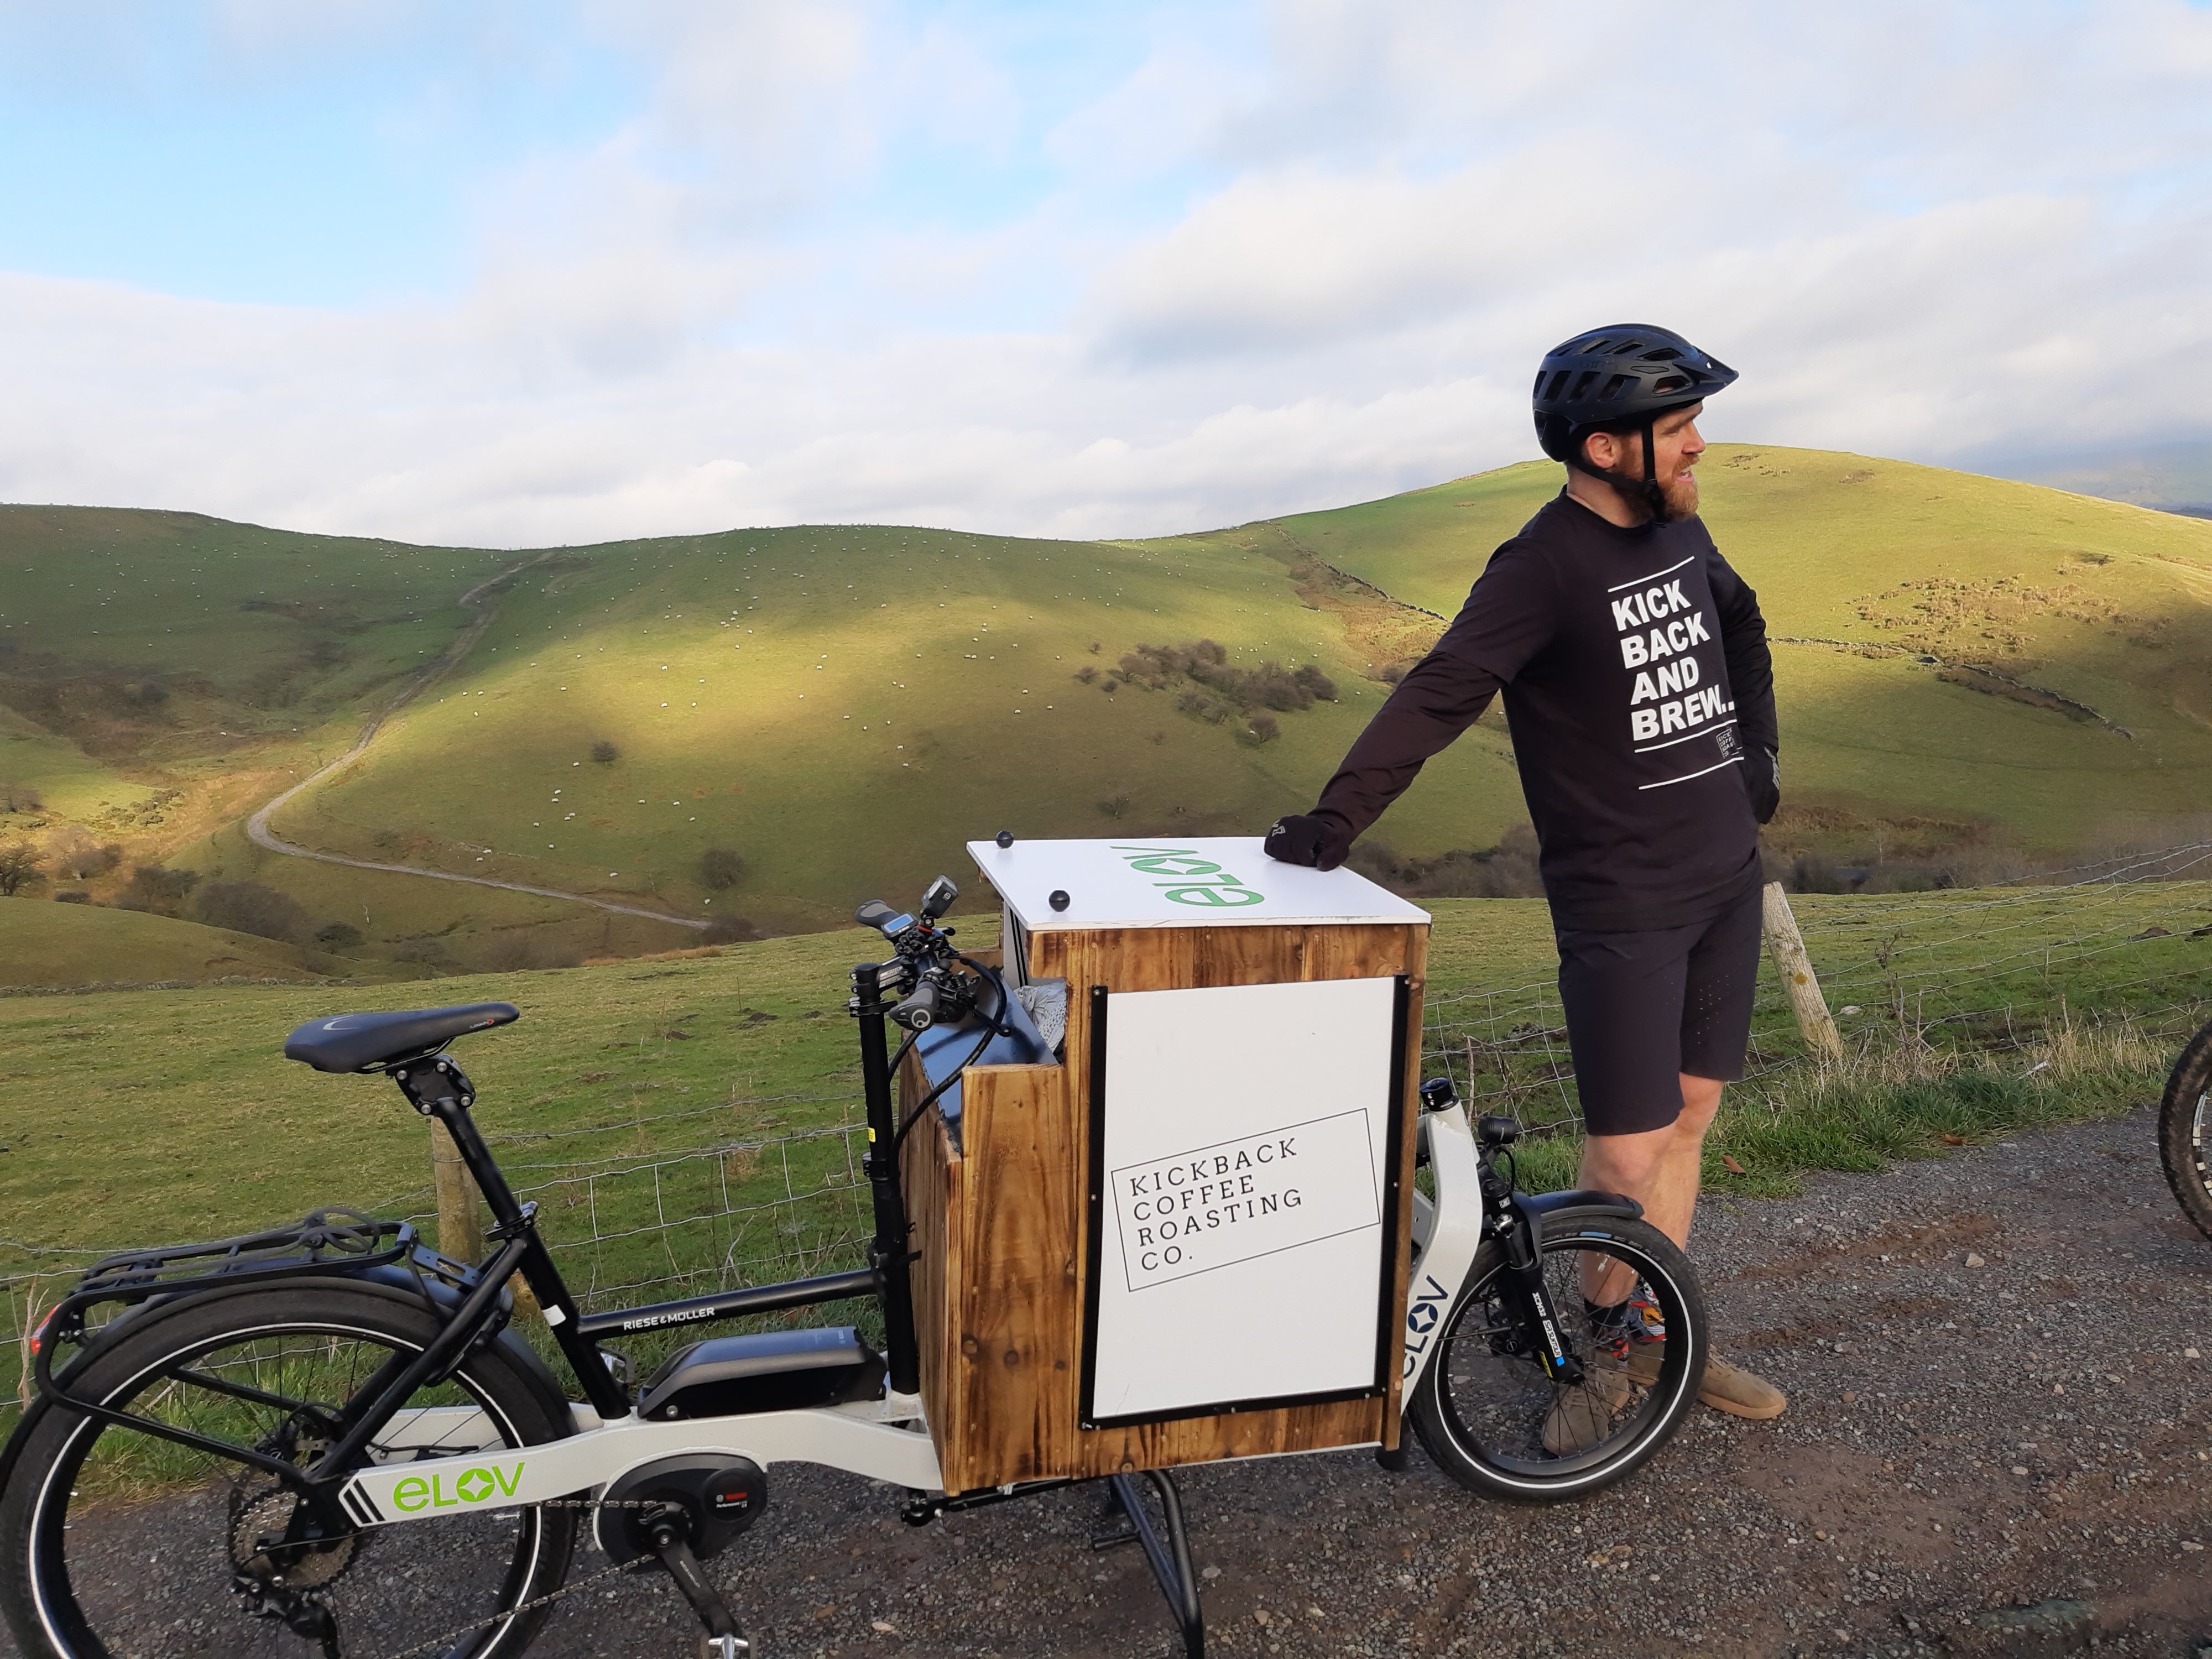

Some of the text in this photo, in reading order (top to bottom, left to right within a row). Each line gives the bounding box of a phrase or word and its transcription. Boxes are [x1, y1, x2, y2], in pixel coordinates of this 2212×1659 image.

[1611, 578, 1692, 632] KICK
[1620, 611, 1711, 669] BACK
[1630, 656, 1699, 706] AND
[1130, 1138, 1297, 1197] KICKBACK
[1134, 1175, 1254, 1220] COFFEE
[1138, 1189, 1301, 1247] ROASTING
[1141, 1246, 1193, 1270] CO.
